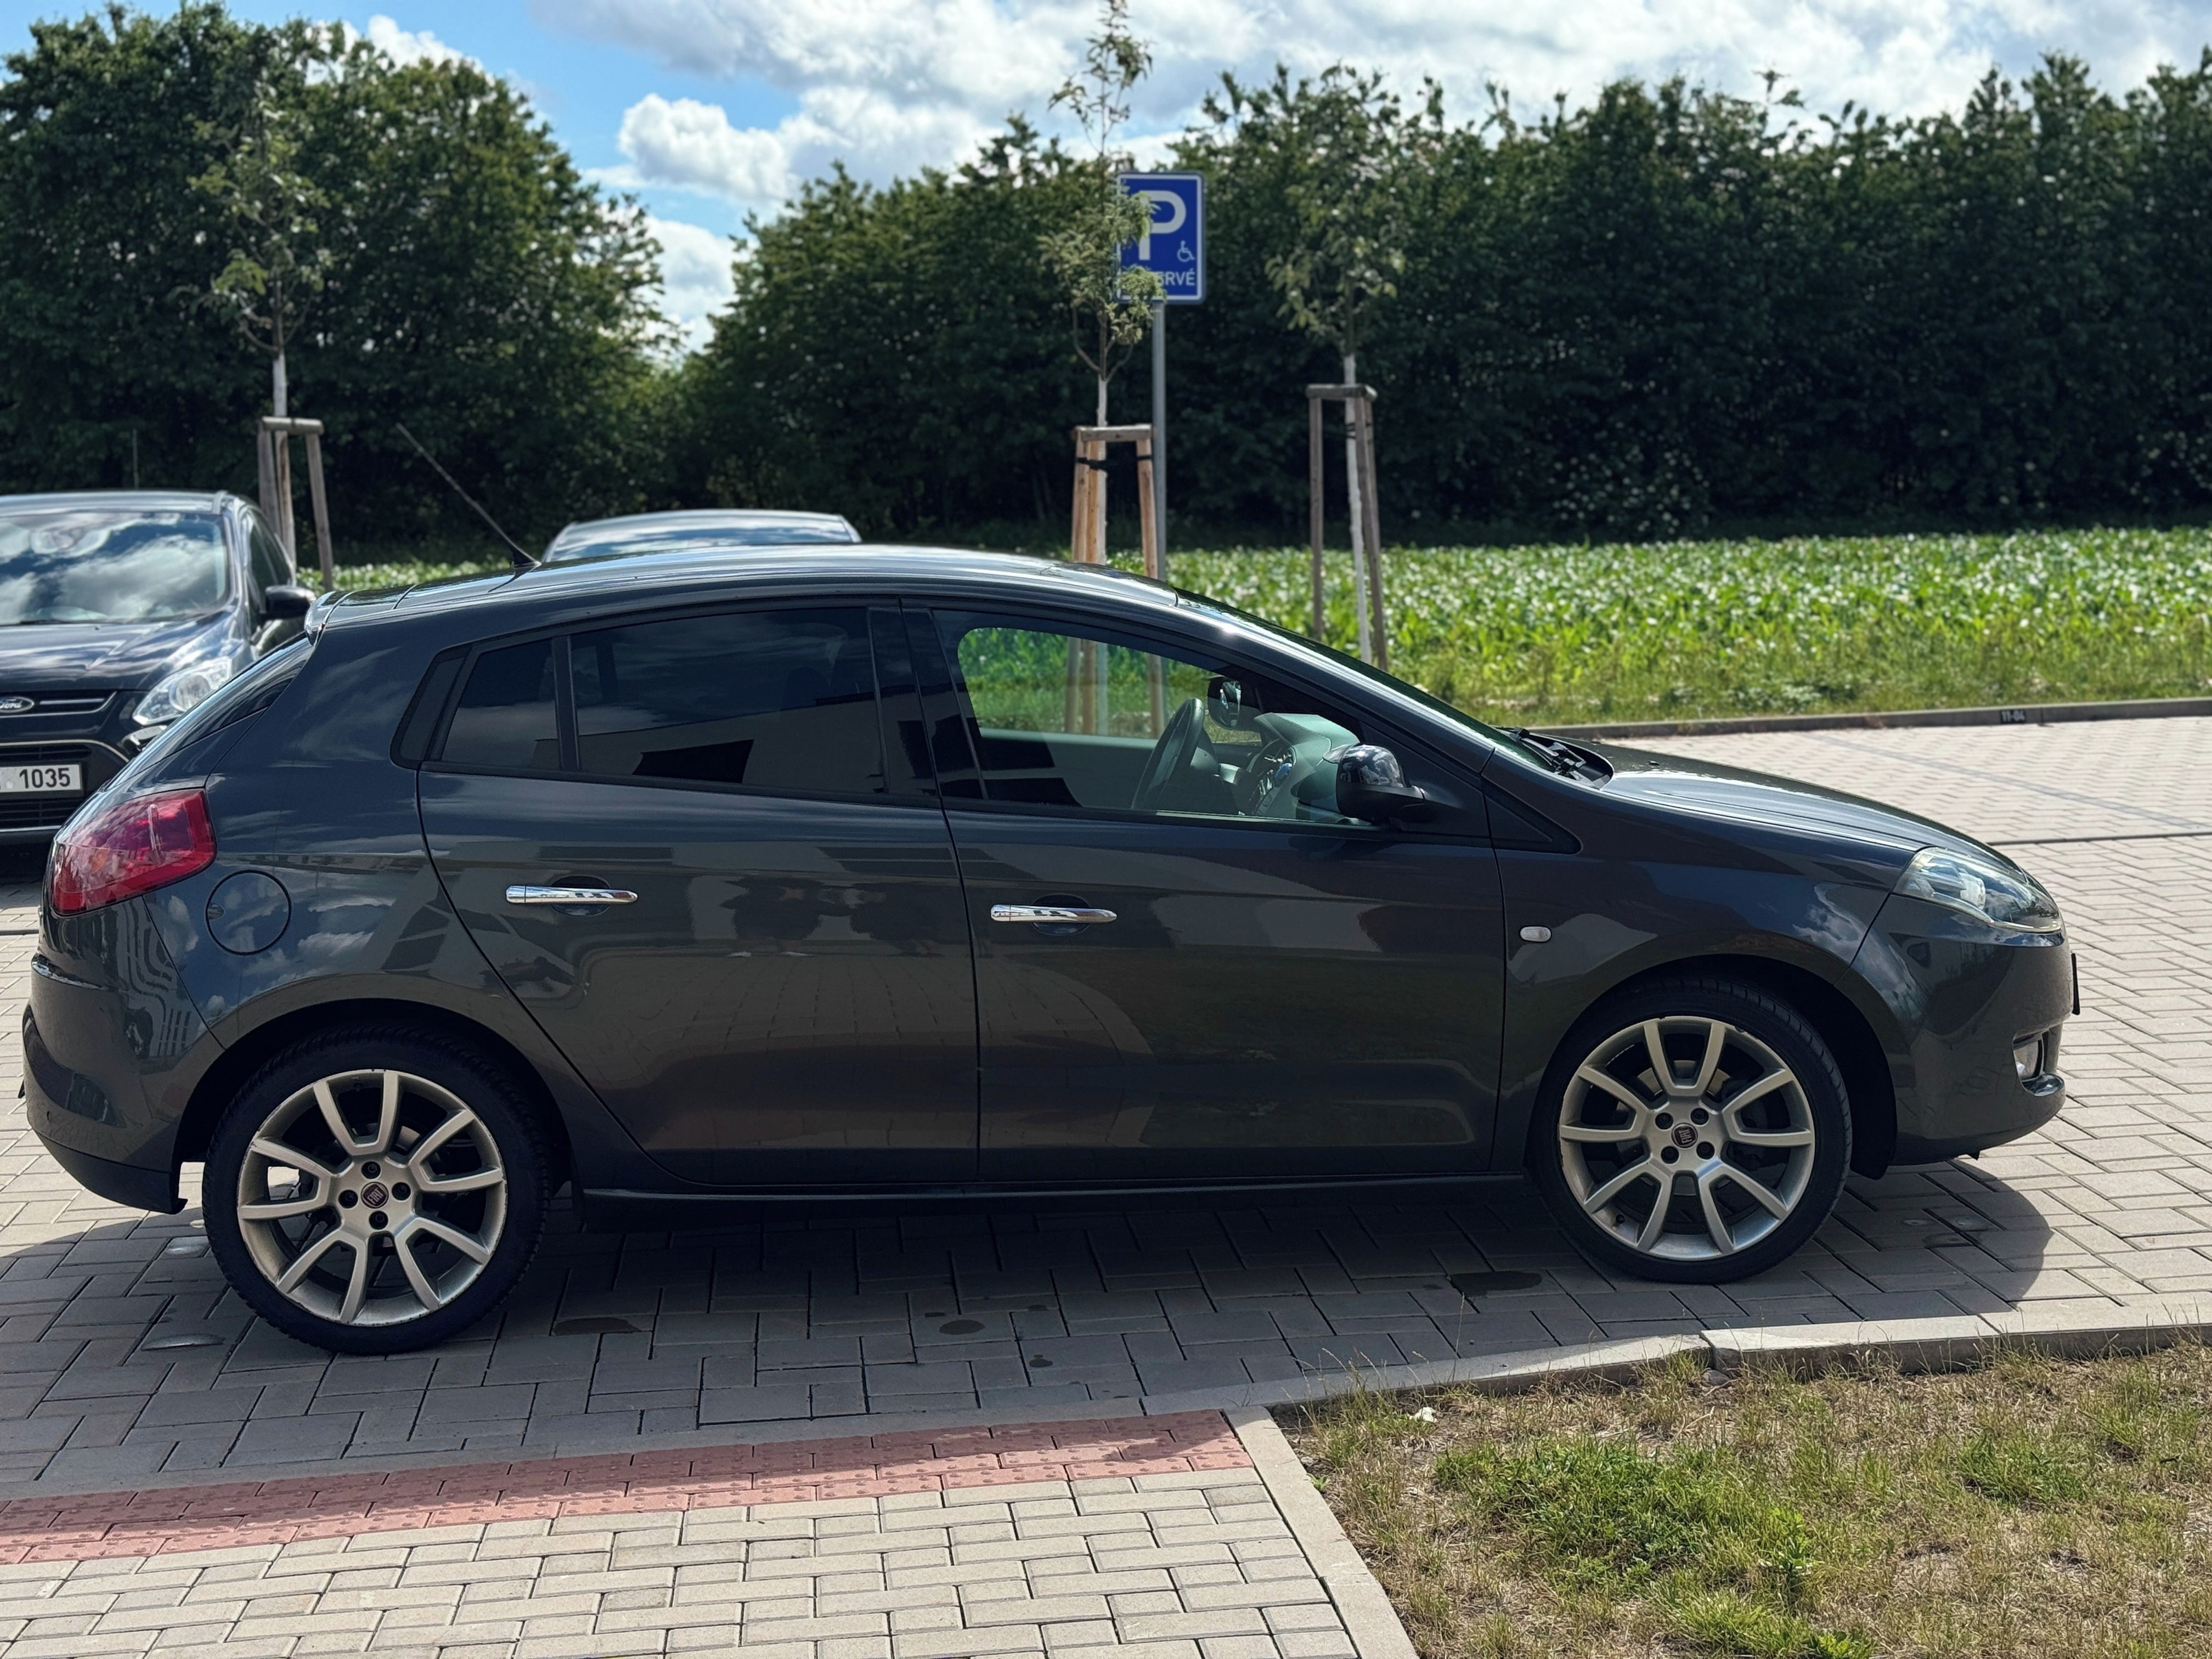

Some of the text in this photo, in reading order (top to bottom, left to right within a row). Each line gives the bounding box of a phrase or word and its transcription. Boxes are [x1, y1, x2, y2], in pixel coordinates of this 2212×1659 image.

[1138, 190, 1187, 261] P
[1155, 268, 1195, 286] ERVÉ
[0, 698, 23, 709] Ford
[19, 767, 71, 789] 1035
[366, 1188, 384, 1205] FIAT
